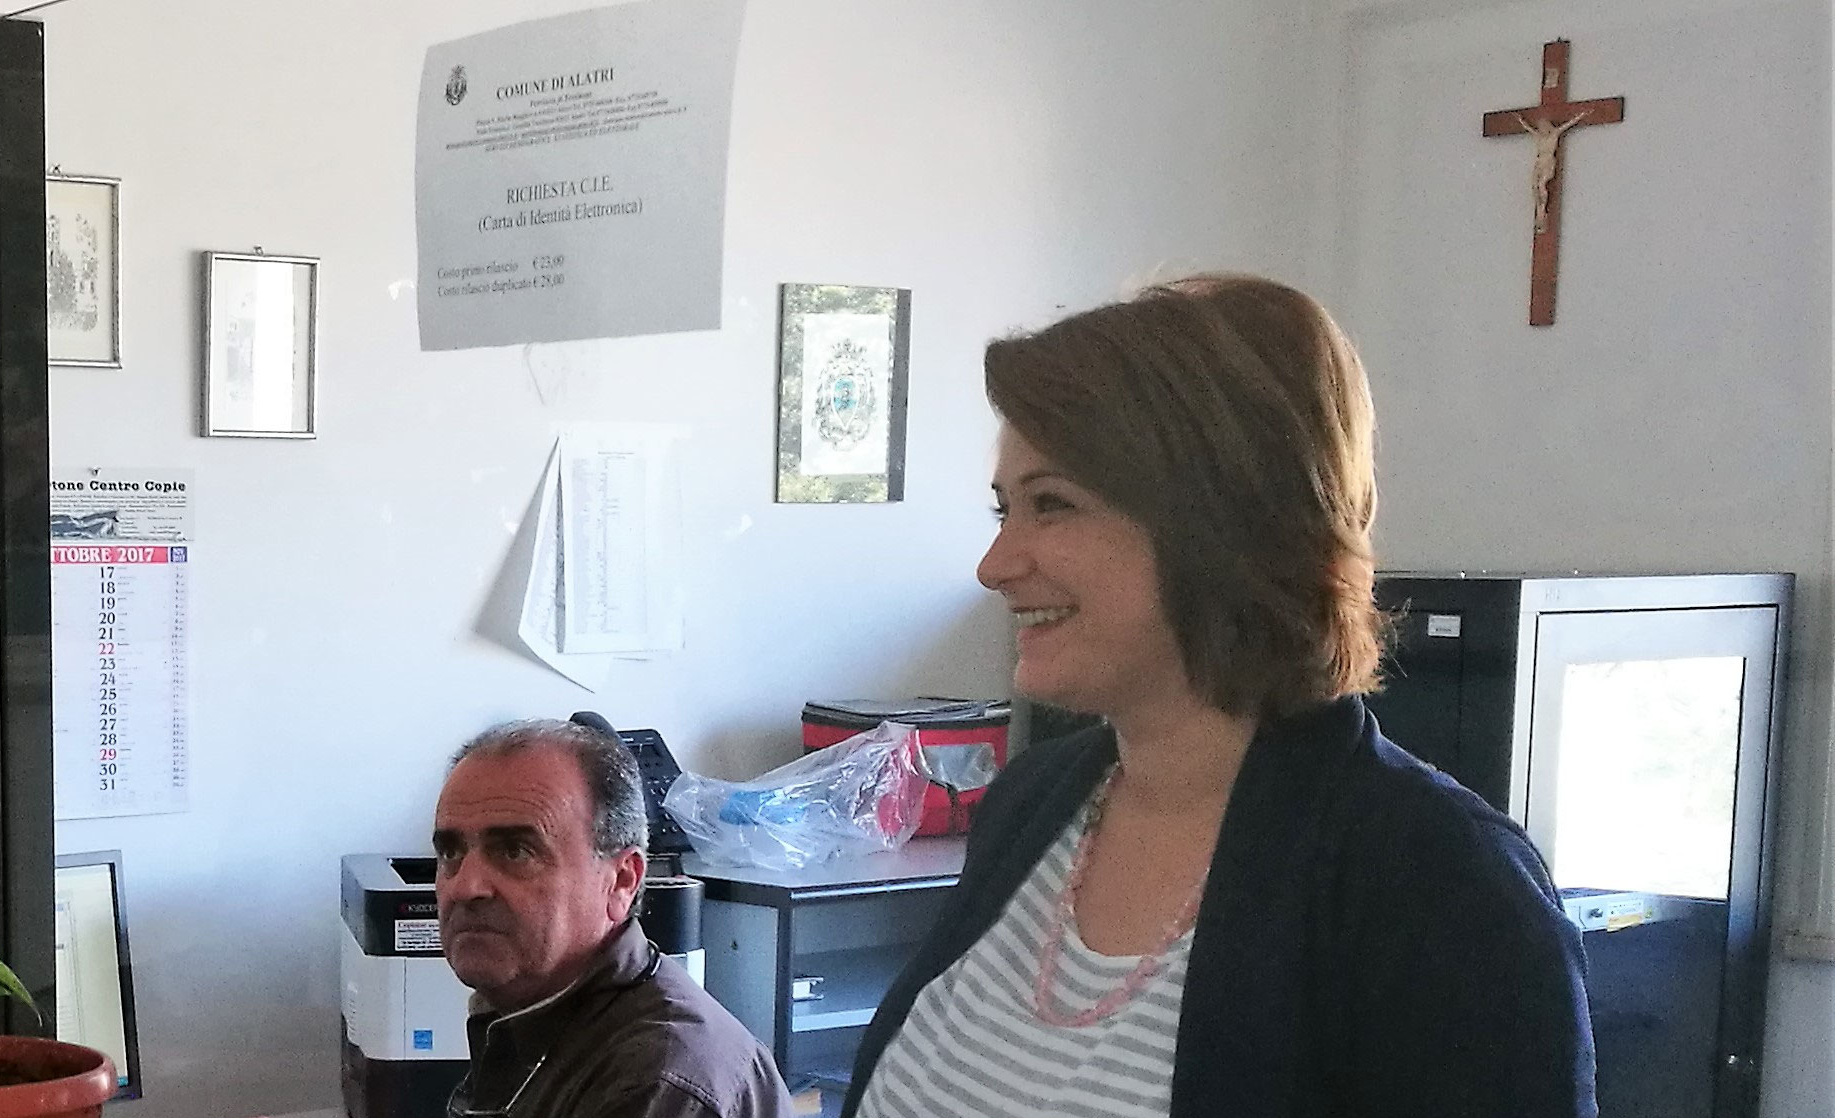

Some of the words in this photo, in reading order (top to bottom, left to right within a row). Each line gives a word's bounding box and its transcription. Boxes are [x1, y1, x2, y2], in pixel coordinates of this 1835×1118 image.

[496, 78, 545, 100] COMUNE
[551, 75, 564, 91] DI
[569, 67, 615, 88] ALATRI
[507, 180, 576, 204] RICHIESTA
[580, 175, 613, 195] C.I.E.
[478, 214, 513, 233] (Carta
[517, 211, 526, 227] di
[530, 206, 571, 226] Identità
[575, 197, 644, 220] Elettronica)
[51, 481, 84, 491] tone
[89, 480, 140, 491] Centro
[144, 480, 186, 493] Copie
[51, 547, 112, 563] TTOBRE
[117, 547, 155, 563] 2017
[100, 566, 115, 579] 17
[101, 581, 115, 594] 18
[100, 597, 115, 610] 19
[98, 612, 115, 624] 20
[98, 627, 113, 640] 21
[98, 642, 115, 655] 22
[99, 658, 115, 670] 23
[99, 673, 115, 685] 24
[99, 688, 117, 700] 25
[99, 703, 117, 715] 26
[99, 718, 117, 730] 27
[99, 733, 117, 745] 28
[99, 748, 117, 760] 29
[99, 763, 117, 775] 30
[99, 779, 115, 790] 31
